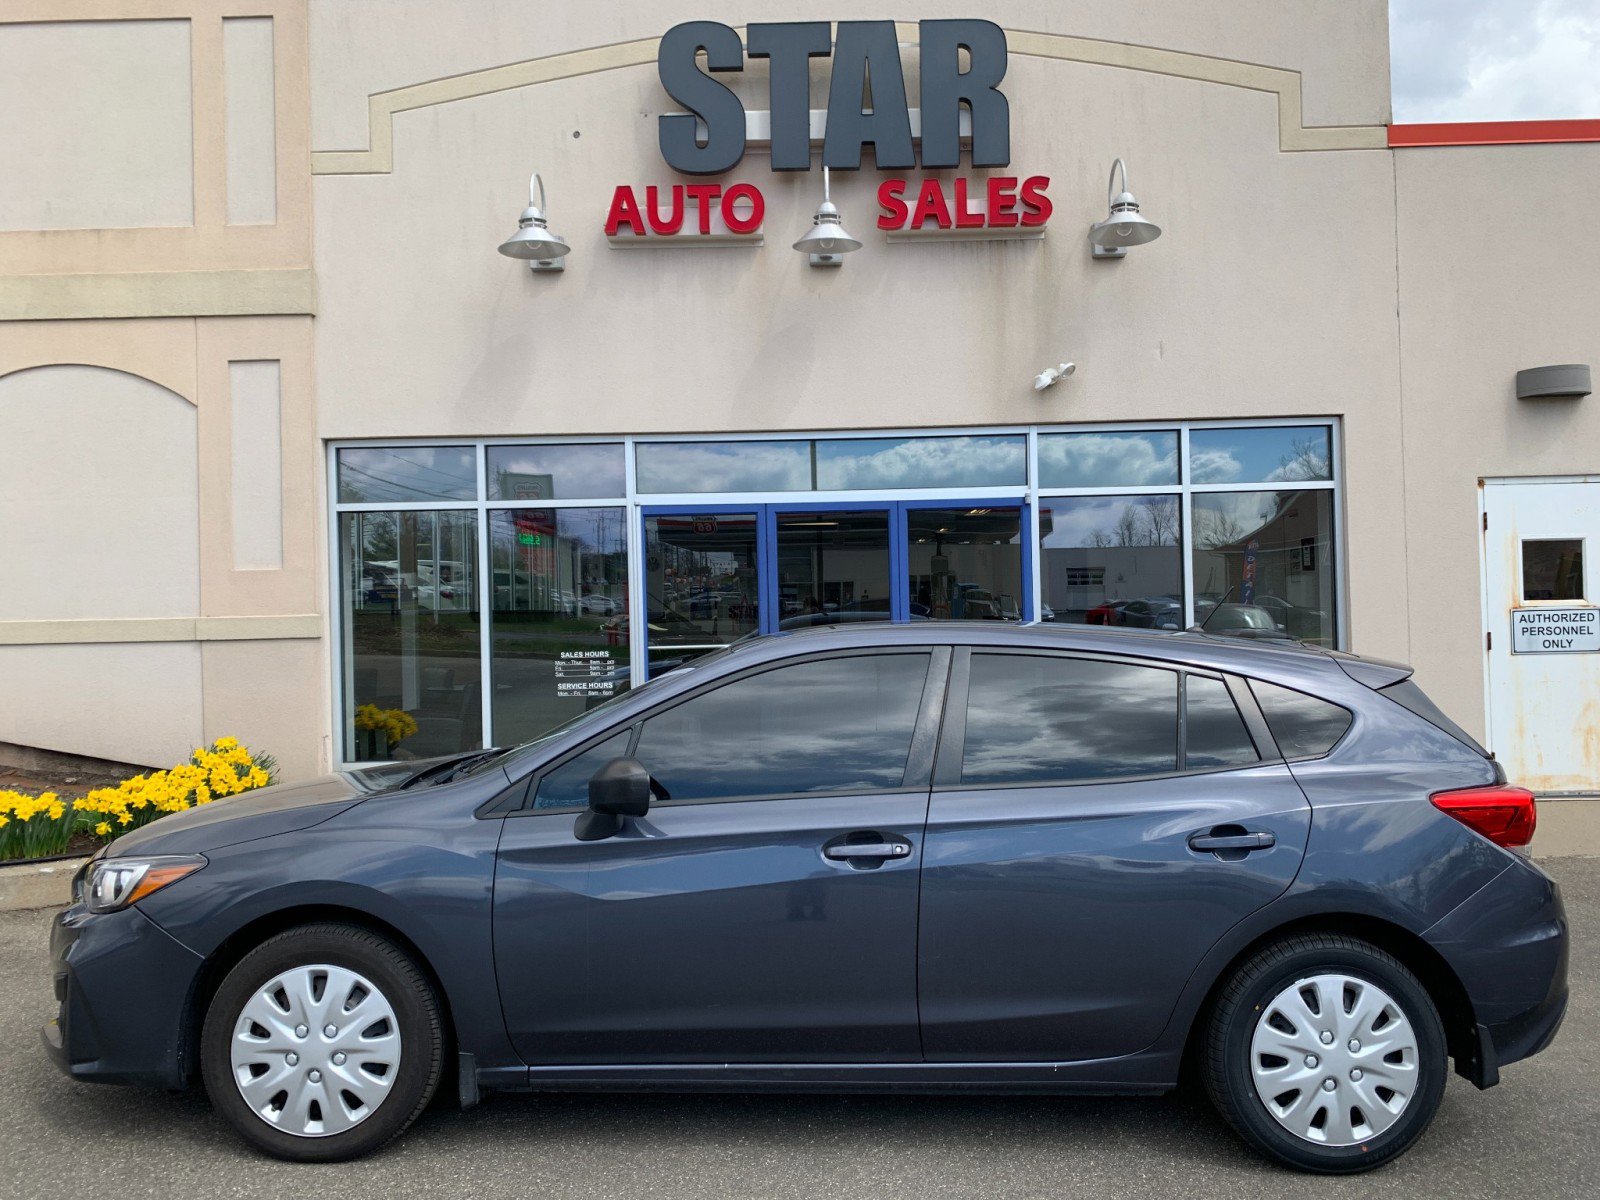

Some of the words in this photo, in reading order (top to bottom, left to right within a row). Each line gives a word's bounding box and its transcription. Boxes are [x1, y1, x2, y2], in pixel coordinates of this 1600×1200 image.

[658, 18, 1010, 176] STAR
[604, 183, 765, 236] AUTO
[877, 175, 1053, 231] SALES
[1519, 613, 1595, 623] AUTHORIZED
[1522, 626, 1594, 636] PERSONNEL
[1542, 639, 1574, 649] ONLY
[557, 682, 587, 690] SERVICE
